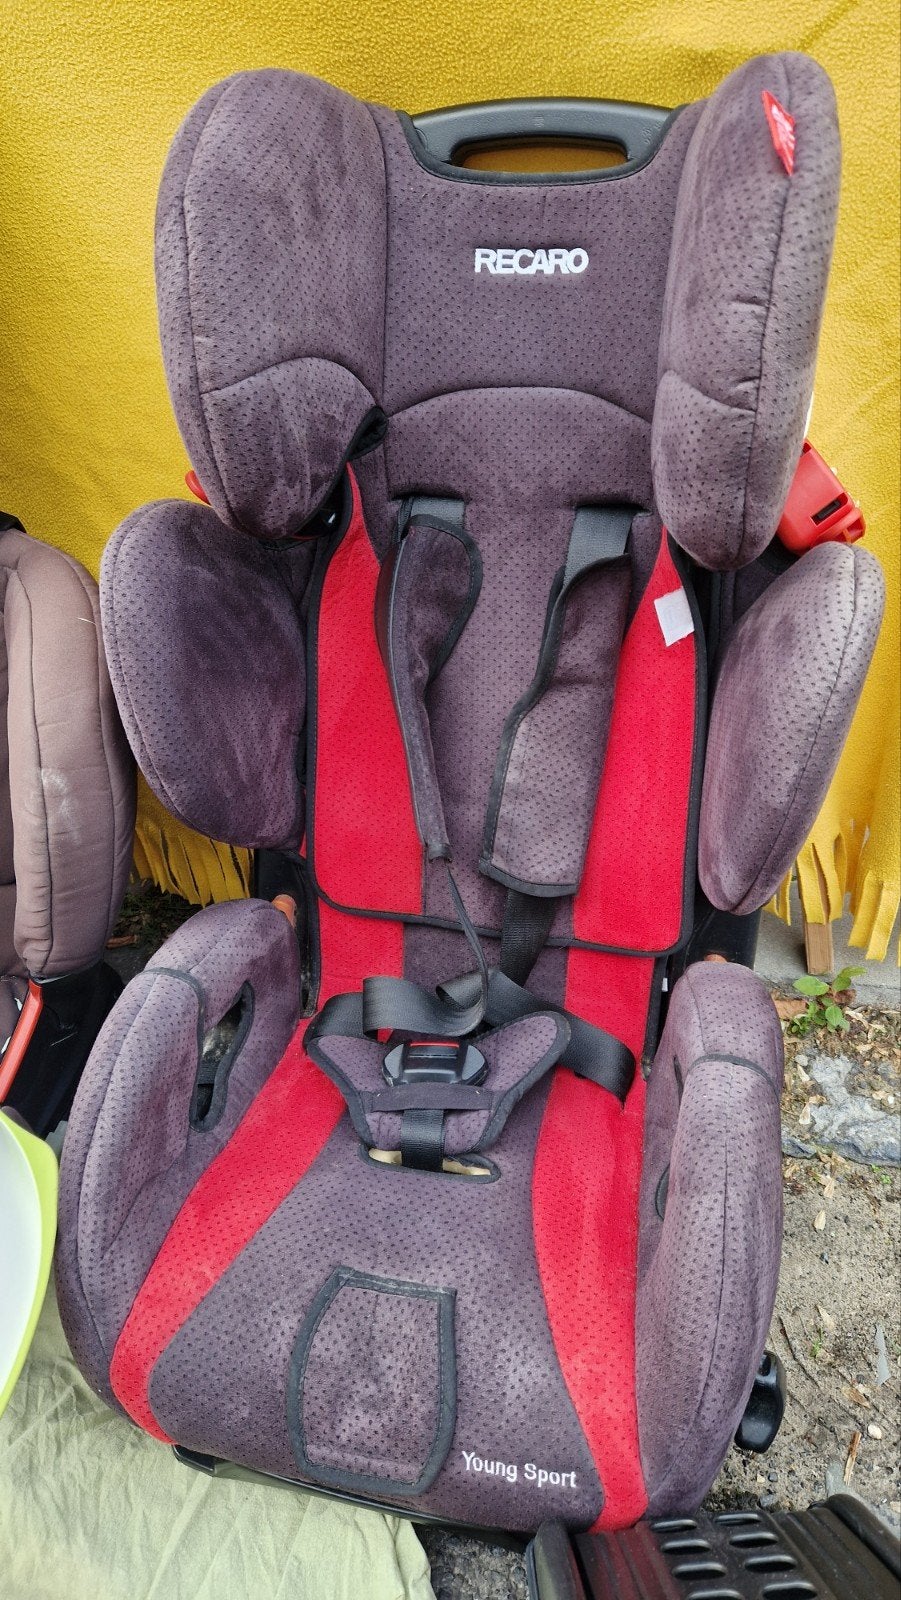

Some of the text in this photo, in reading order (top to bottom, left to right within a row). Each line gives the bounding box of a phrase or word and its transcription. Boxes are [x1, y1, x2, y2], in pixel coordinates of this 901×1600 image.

[474, 247, 590, 275] RECARO
[461, 1450, 577, 1488] Young Sport
